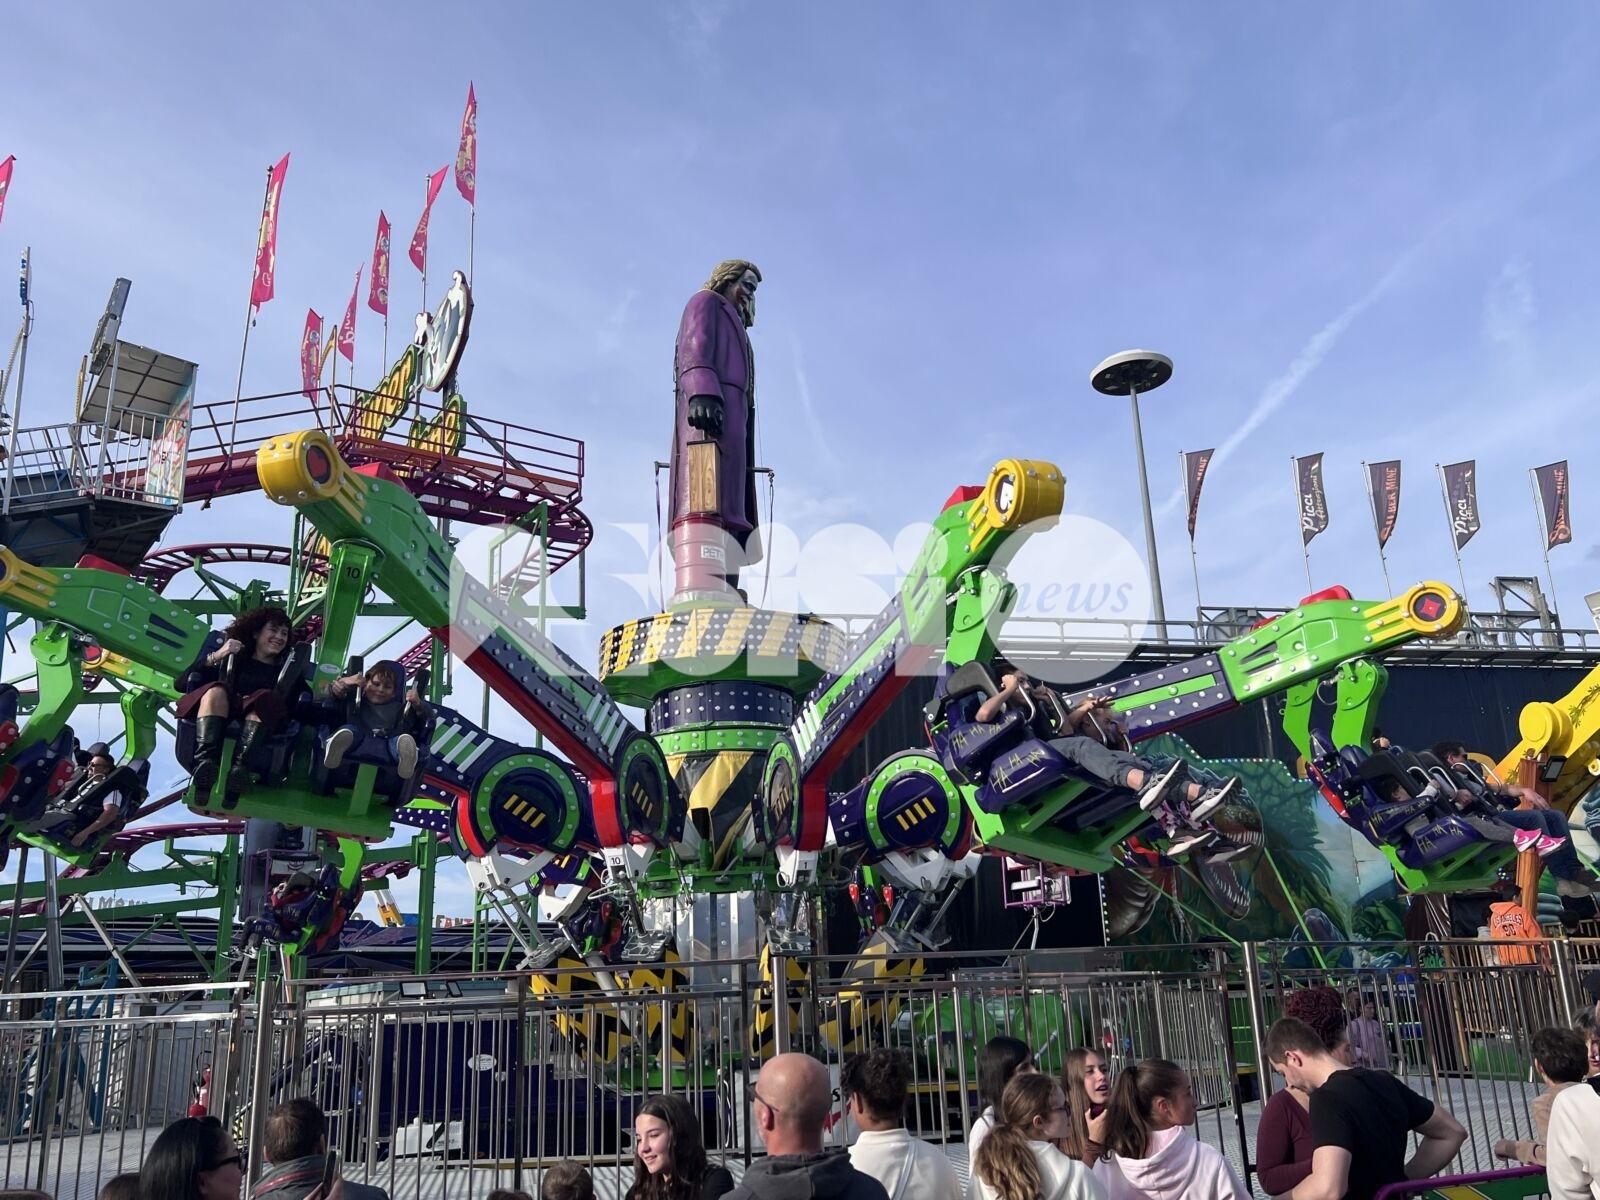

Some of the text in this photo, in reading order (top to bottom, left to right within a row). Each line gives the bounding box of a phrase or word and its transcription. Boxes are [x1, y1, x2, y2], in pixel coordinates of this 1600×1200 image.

[1385, 467, 1397, 490] MINE
[1302, 493, 1319, 532] Picci
[1454, 499, 1469, 535] Picci
[345, 566, 360, 579] 10
[952, 730, 969, 755] HA
[968, 724, 985, 737] HA
[988, 765, 1014, 793] HA
[611, 856, 621, 865] 10
[1502, 923, 1517, 937] 90
